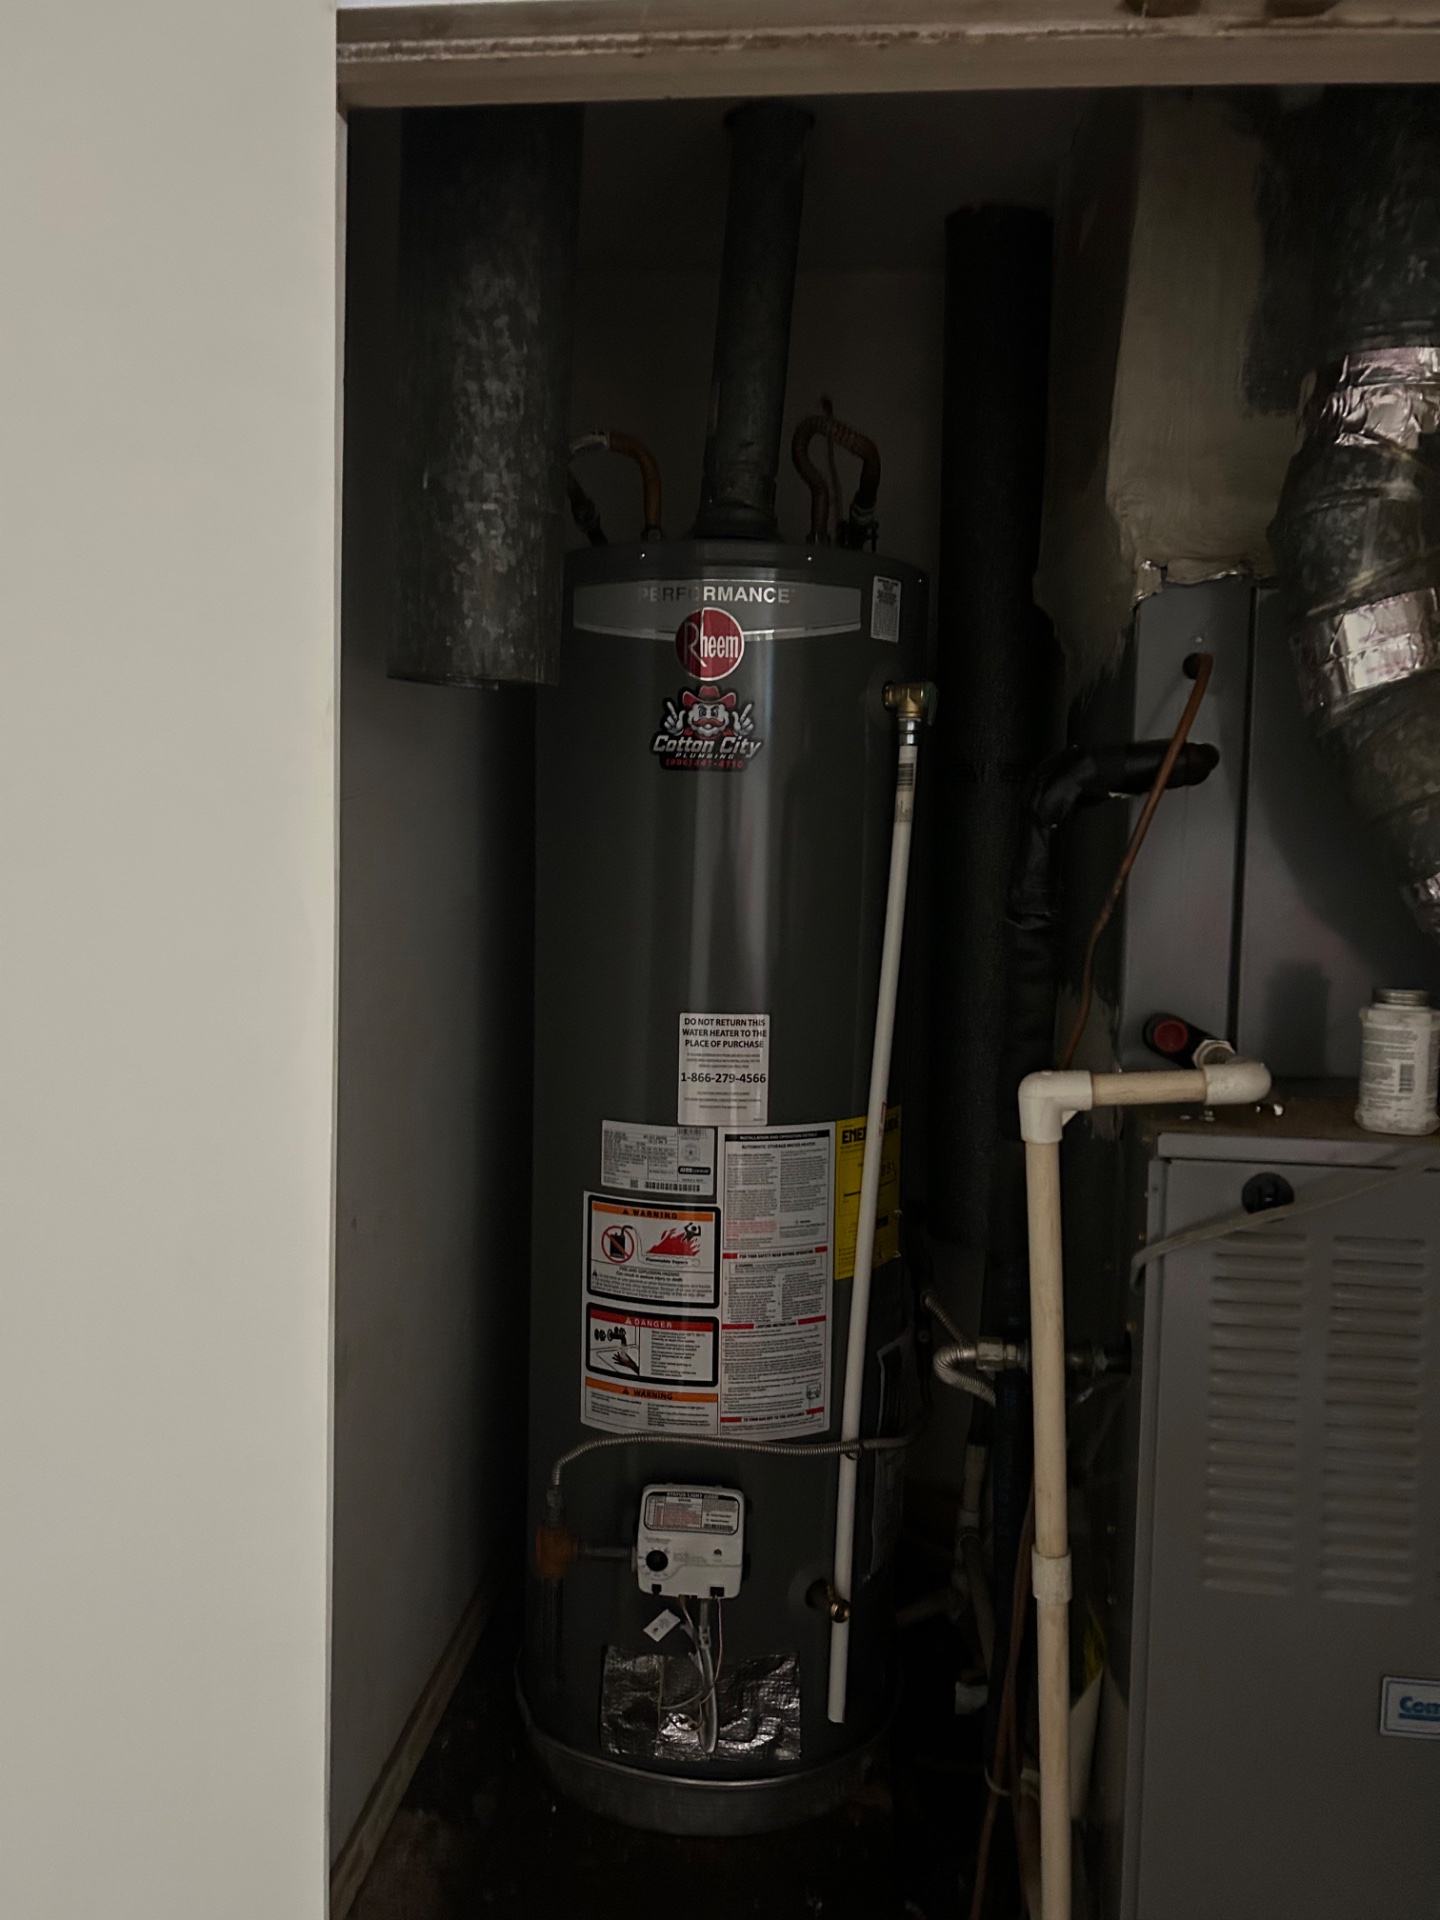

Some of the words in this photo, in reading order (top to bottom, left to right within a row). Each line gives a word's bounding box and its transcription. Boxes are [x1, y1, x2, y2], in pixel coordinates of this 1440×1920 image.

[638, 586, 790, 603] PERFORMANCE
[684, 620, 739, 667] Rheem
[653, 735, 715, 752] Cotton
[720, 735, 761, 758] City
[698, 1018, 714, 1026] NOT
[748, 1019, 765, 1027] THIS
[710, 1029, 739, 1037] HEATER
[710, 1040, 722, 1048] OF
[680, 1072, 766, 1083] 1-866-279-4566
[633, 1209, 678, 1219] WARNING
[634, 1319, 672, 1328] DANGER
[633, 1390, 673, 1400] WARNING
